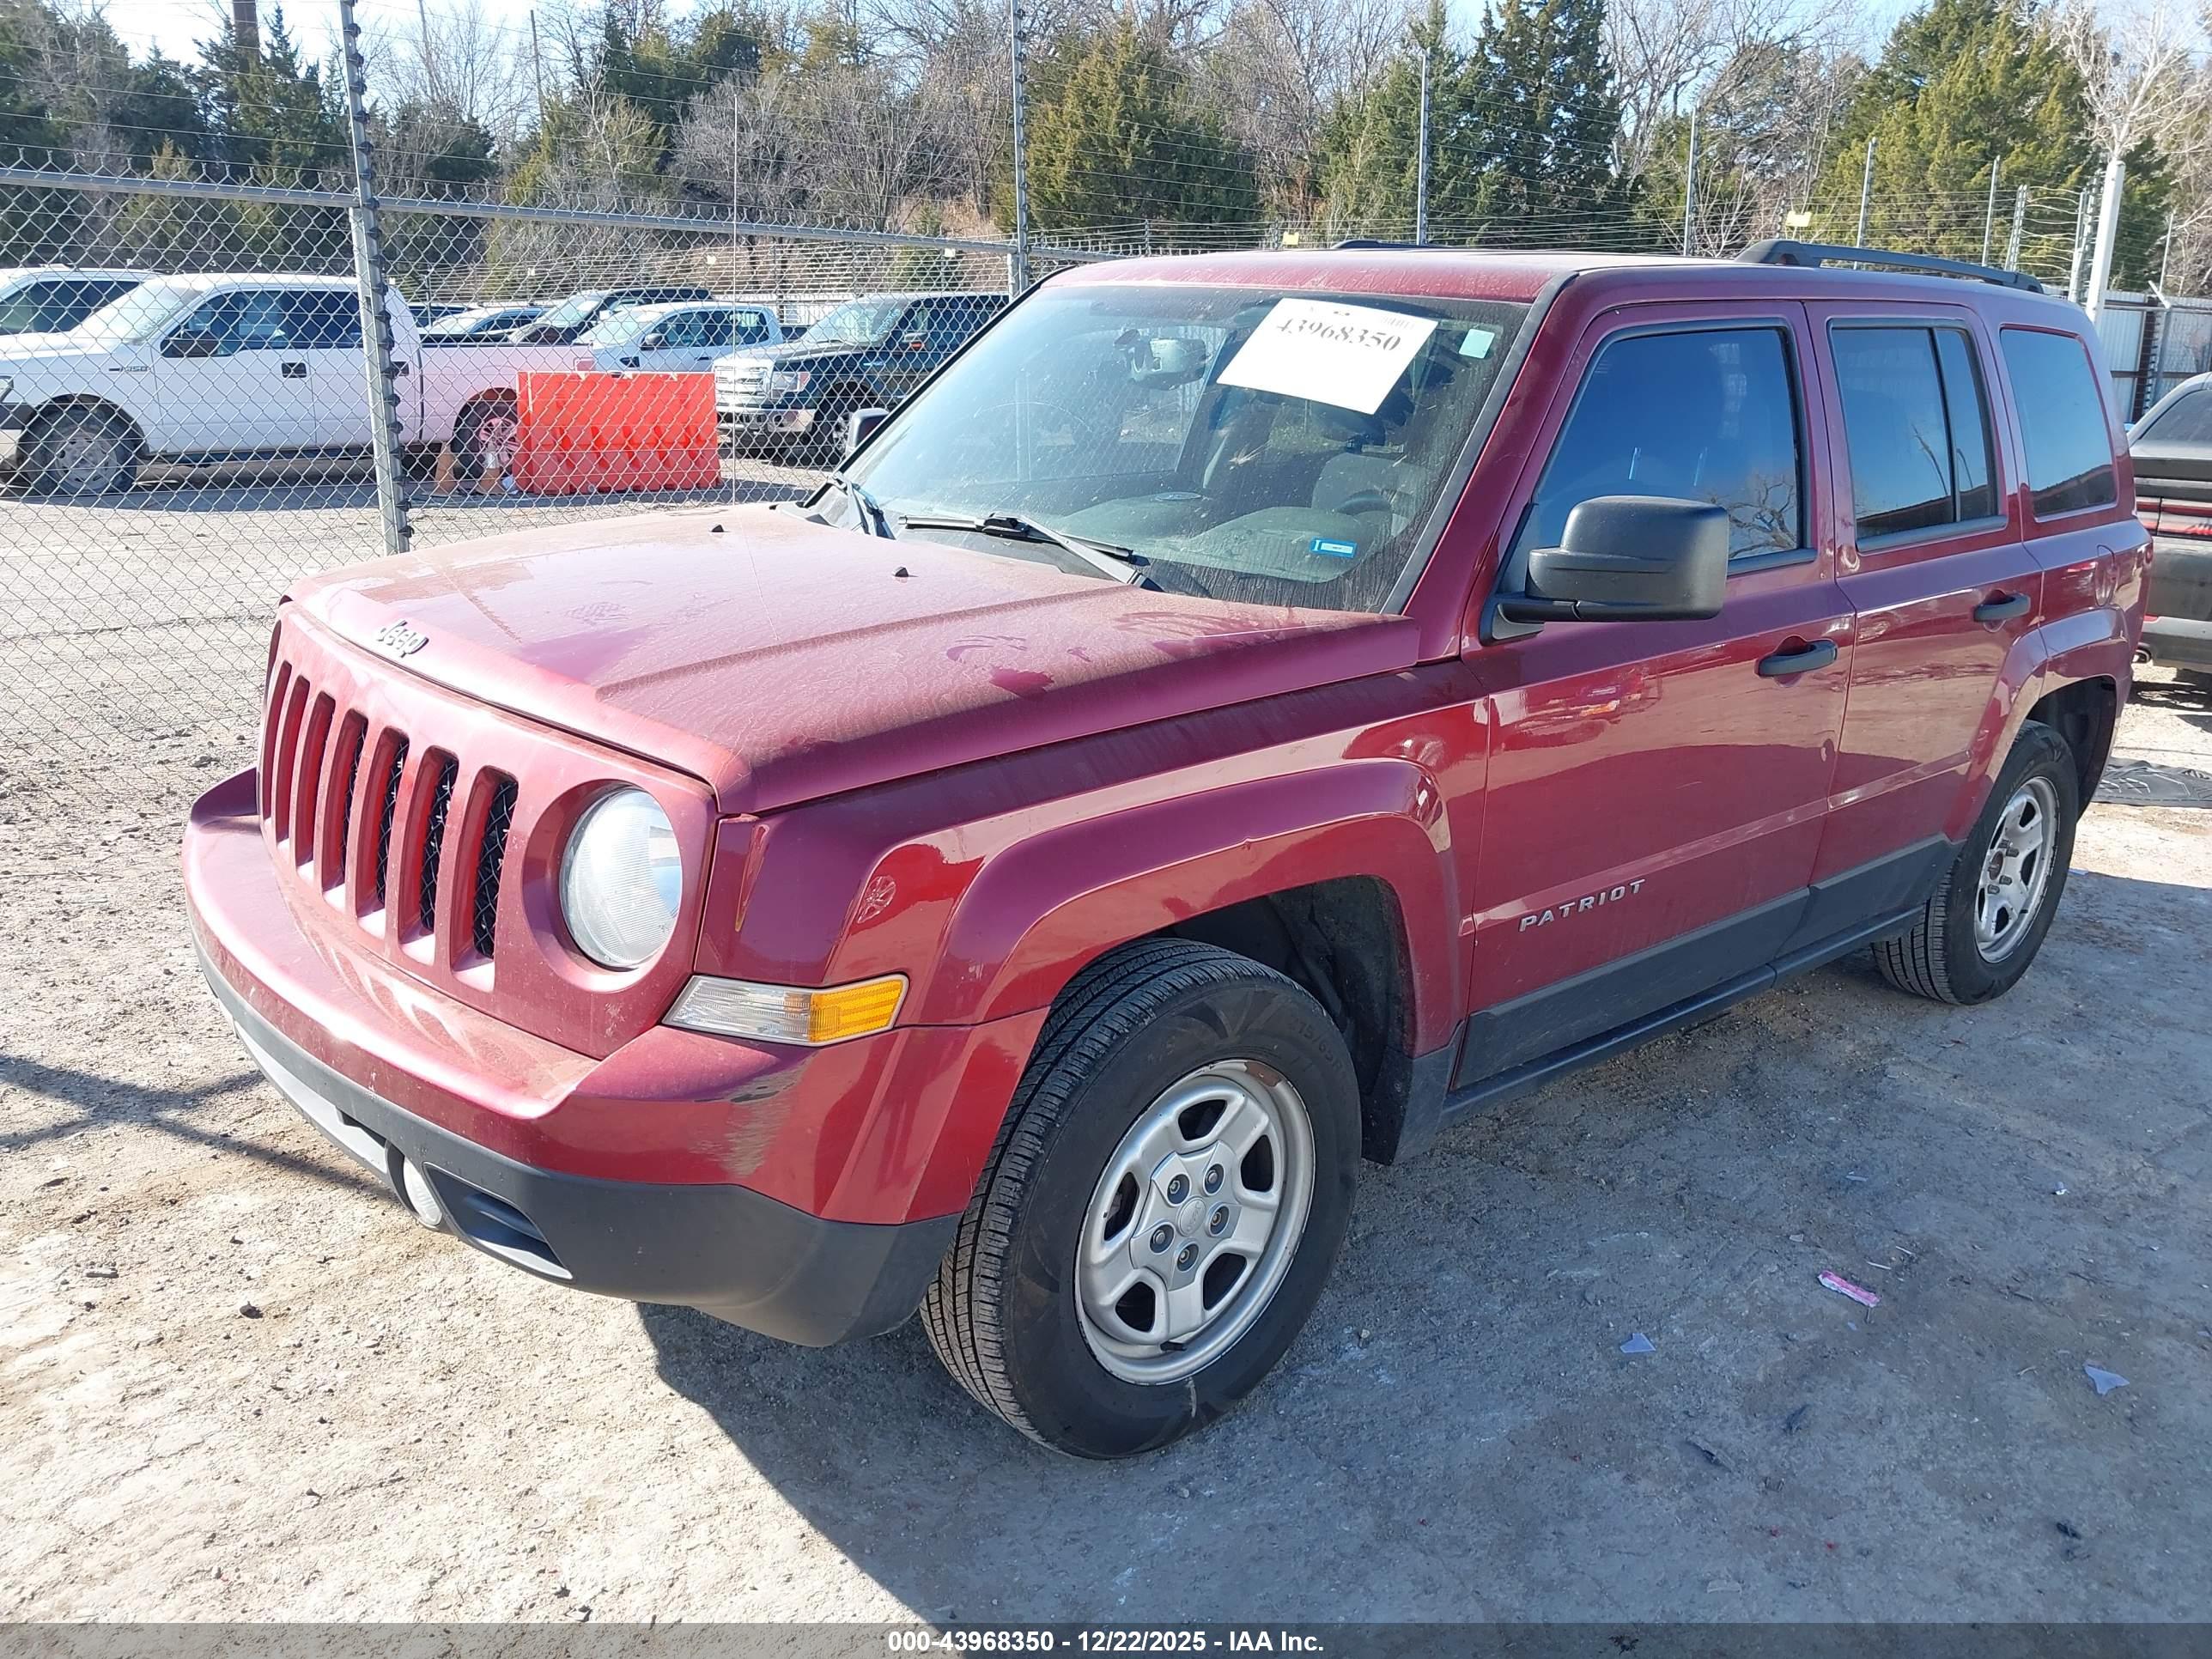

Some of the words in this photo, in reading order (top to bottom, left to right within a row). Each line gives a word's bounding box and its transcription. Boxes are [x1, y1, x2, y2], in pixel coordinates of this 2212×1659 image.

[1276, 317, 1402, 352] 43968350
[376, 618, 430, 659] Jeep
[1518, 878, 1645, 933] PATRIOT
